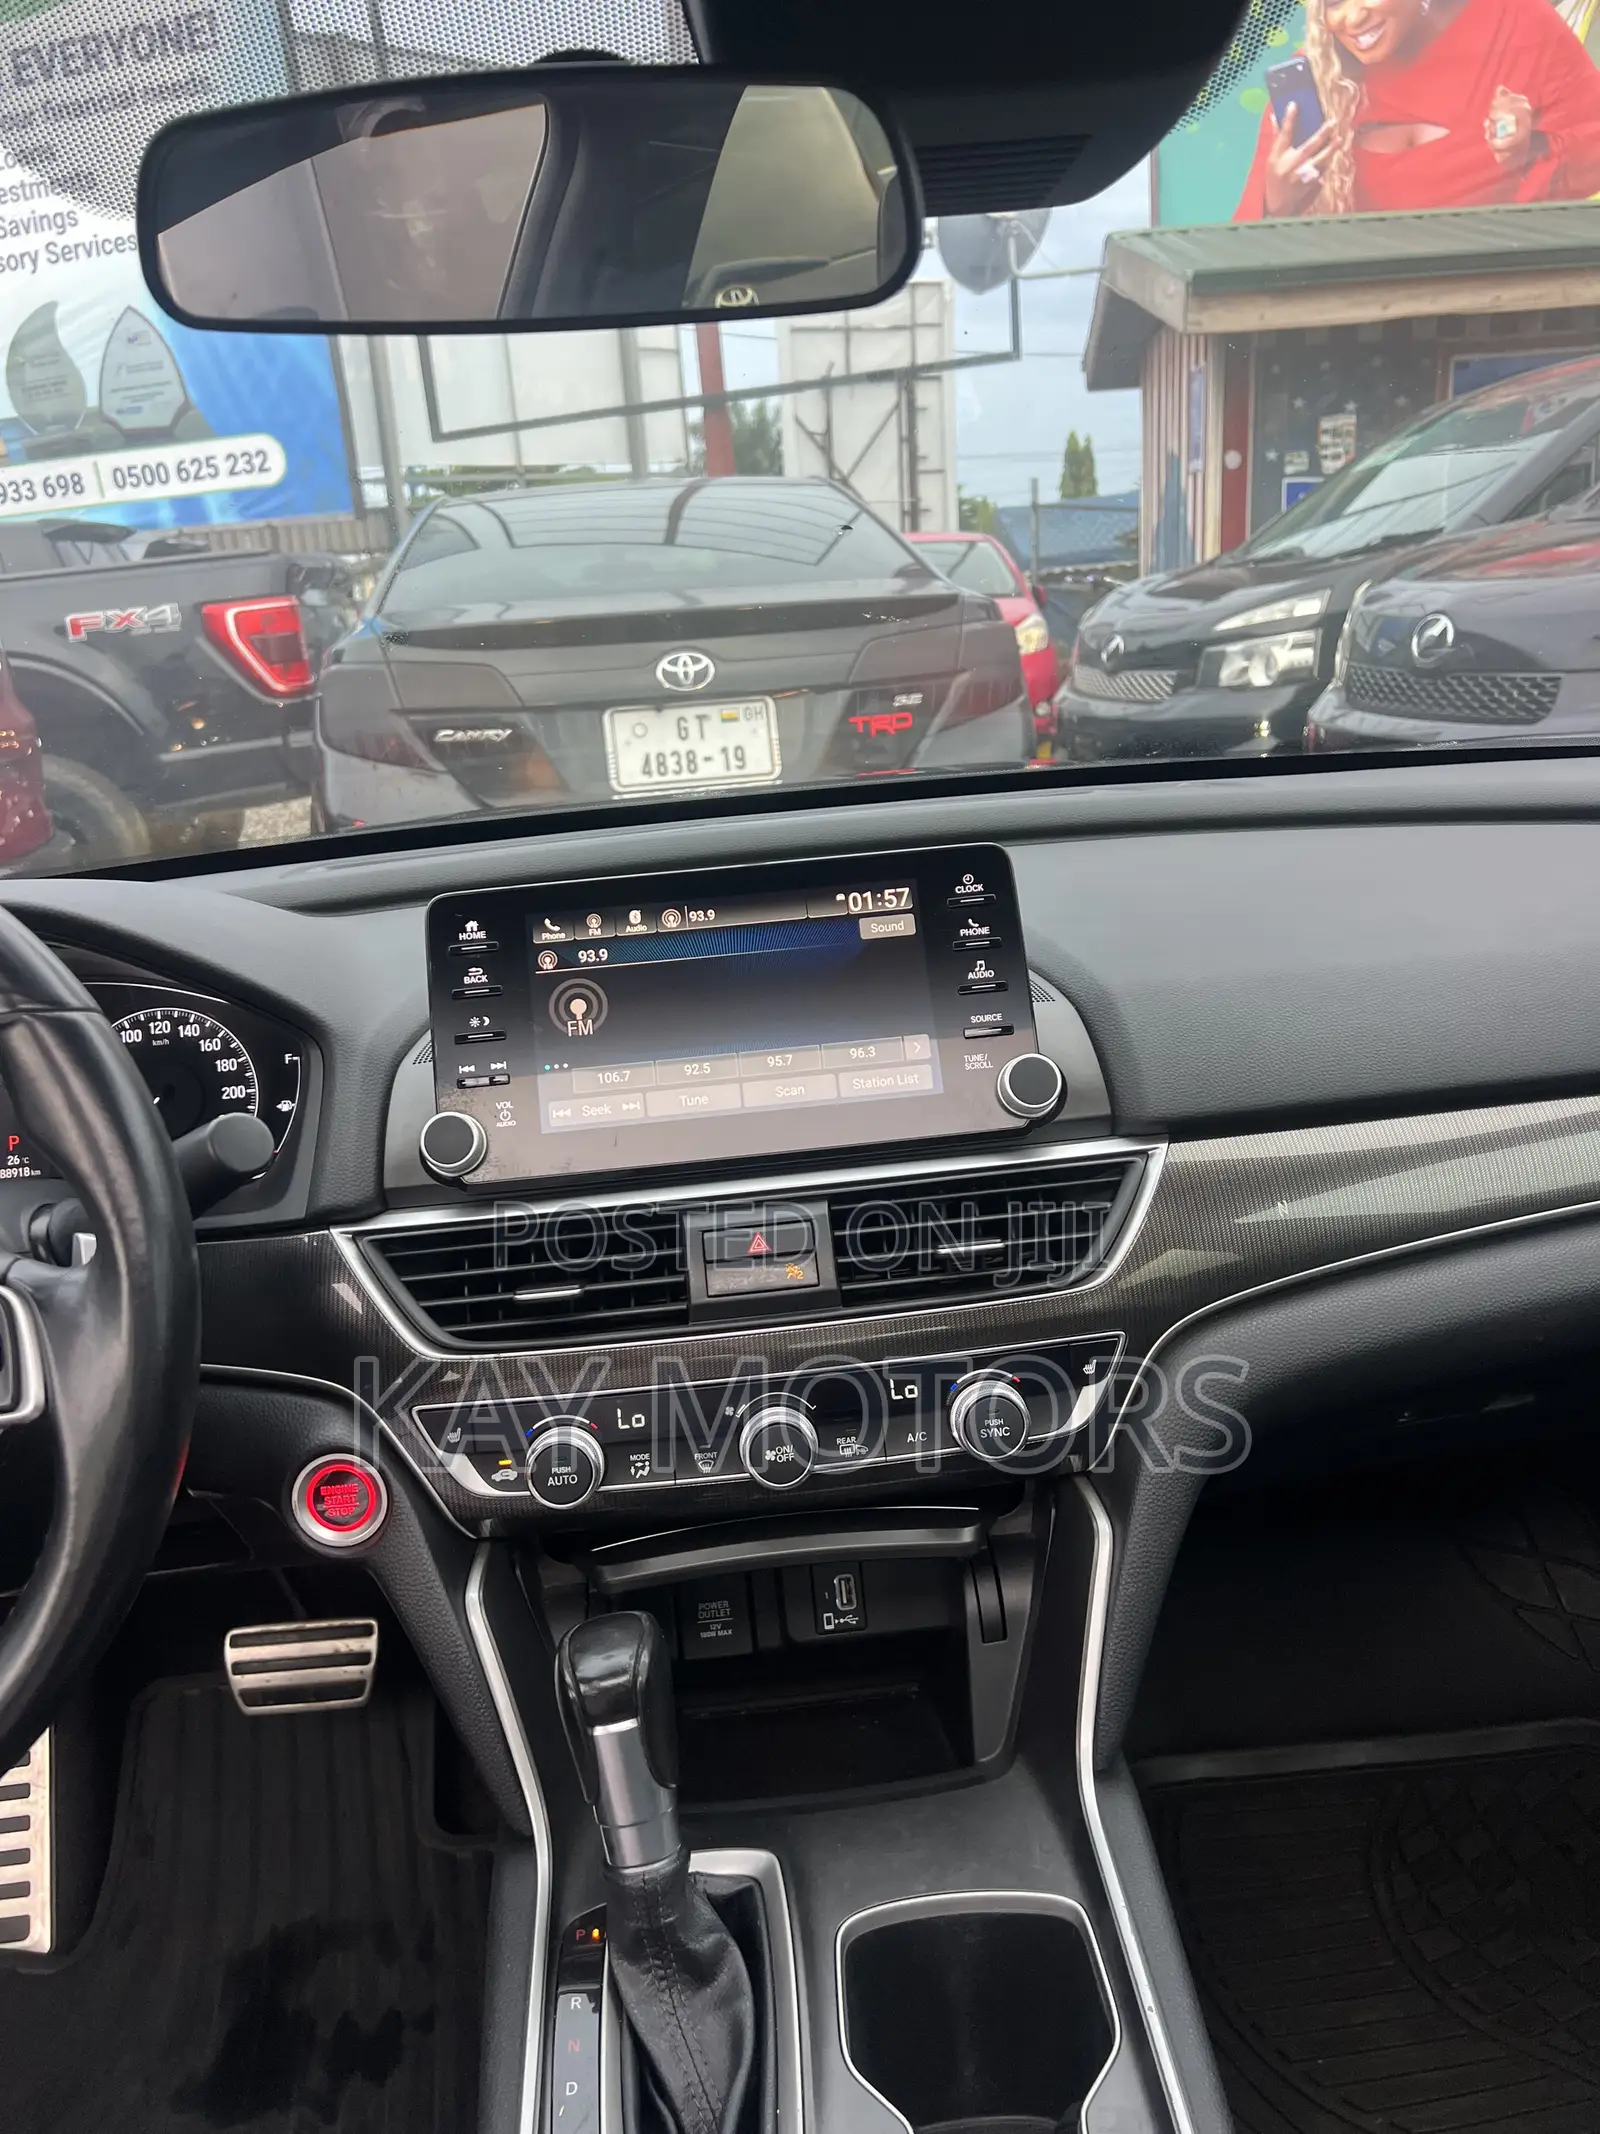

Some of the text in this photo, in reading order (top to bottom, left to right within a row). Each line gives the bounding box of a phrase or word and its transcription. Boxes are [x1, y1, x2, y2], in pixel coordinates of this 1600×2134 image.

[12, 10, 218, 86] EVERYONE!
[45, 233, 138, 264] Services
[43, 472, 85, 498] 698
[113, 462, 170, 490] 0500
[177, 455, 220, 483] 625
[228, 449, 271, 477] 232
[64, 602, 182, 642] FX4
[744, 706, 765, 722] GH
[848, 712, 913, 738] TRD
[642, 745, 747, 778] 4838-19
[955, 883, 985, 893] CLOCK
[848, 886, 911, 912] 01:57
[688, 908, 716, 922] 93.9
[588, 927, 602, 937] FM
[625, 923, 648, 934] Audio
[870, 921, 905, 934] Sound
[959, 926, 991, 937] PHONE
[459, 930, 487, 941] HOME
[541, 931, 566, 941] Phone
[577, 948, 609, 964] 93.9
[463, 974, 489, 985] BACK
[967, 968, 995, 980] AUDIO
[970, 1012, 1003, 1024] SOURCE
[149, 1020, 171, 1035] 120
[177, 1023, 200, 1038] 140
[566, 1019, 594, 1037] FM
[120, 1029, 142, 1044] 100
[152, 1038, 170, 1047] km/h
[199, 1036, 222, 1053] 160
[285, 1053, 293, 1064] F
[849, 1046, 876, 1060] 96.3
[963, 1053, 988, 1063] TUNE/
[215, 1057, 238, 1073] 180
[766, 1054, 793, 1068] 95.7
[964, 1060, 994, 1071] SCROLL
[684, 1062, 711, 1076] 92.5
[597, 1070, 631, 1085] 106.7
[852, 1072, 920, 1091] Station List
[221, 1085, 247, 1101] 200
[774, 1084, 805, 1098] Scan
[495, 1101, 514, 1110] VOL
[679, 1094, 709, 1107] Tune
[582, 1103, 612, 1117] Seek
[8, 1135, 20, 1151] P
[7, 1154, 20, 1166] 26
[0, 1166, 42, 1179] 88918 km
[890, 1378, 919, 1400] Lo
[616, 1407, 646, 1430] Lo
[984, 1418, 1004, 1428] PUSH
[906, 1430, 928, 1444] A/C
[979, 1426, 1011, 1439] SYNC
[836, 1436, 857, 1445] REAR
[694, 1451, 718, 1461] FRONT
[775, 1444, 793, 1456] ON/
[629, 1453, 650, 1462] MODE
[776, 1453, 795, 1464] OFF
[551, 1465, 572, 1475] PUSH
[546, 1473, 578, 1487] AUTO
[320, 1483, 359, 1496] ENGINE
[323, 1494, 357, 1505] START
[327, 1506, 356, 1518] STOP
[698, 1600, 729, 1611] POWER
[698, 1607, 731, 1619] OUTLET
[709, 1623, 722, 1631] 12V
[717, 1628, 733, 1637] MAX
[576, 1928, 586, 1941] P
[571, 1996, 582, 2010] R
[568, 2039, 581, 2052] N
[565, 2081, 578, 2096] D
